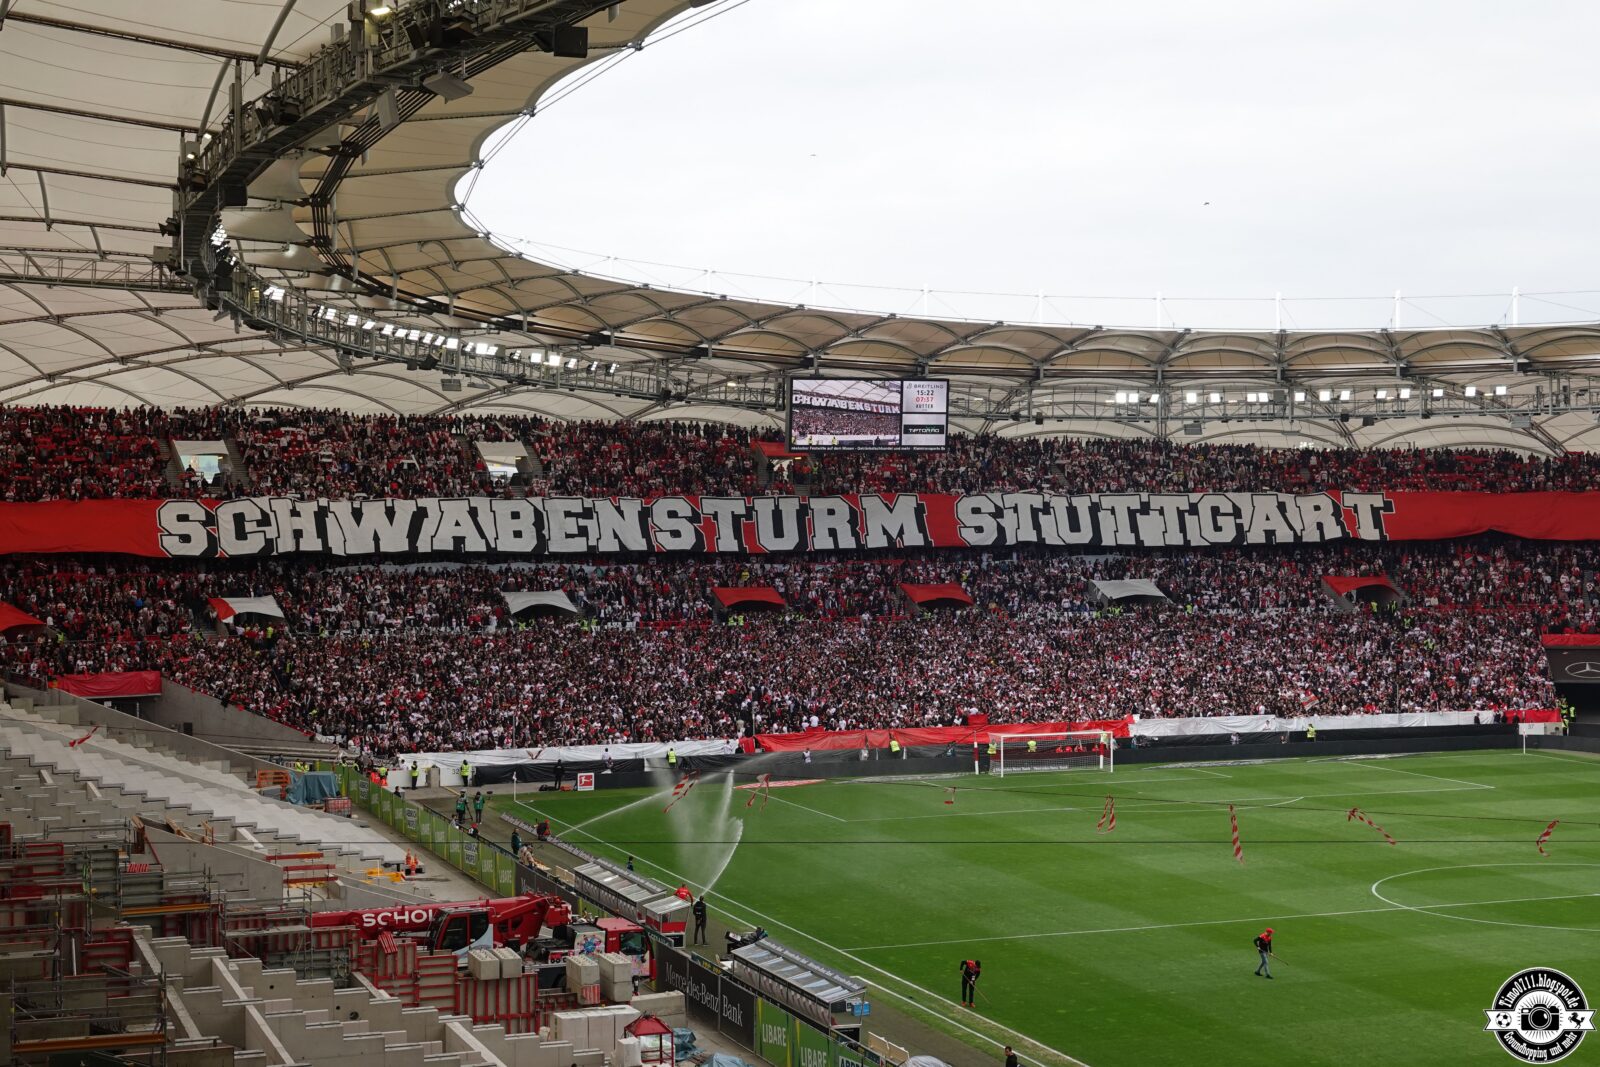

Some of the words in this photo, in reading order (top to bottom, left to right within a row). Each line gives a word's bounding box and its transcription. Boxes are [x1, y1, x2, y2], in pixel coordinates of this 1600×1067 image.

[156, 493, 934, 557] SCHWABENSTURM
[954, 490, 1395, 549] STUTTGART
[666, 961, 719, 1013] Mercedes-Benz
[722, 995, 743, 1027] Bank
[762, 1023, 787, 1047] LIBARE
[800, 1046, 827, 1067] LIBARE
